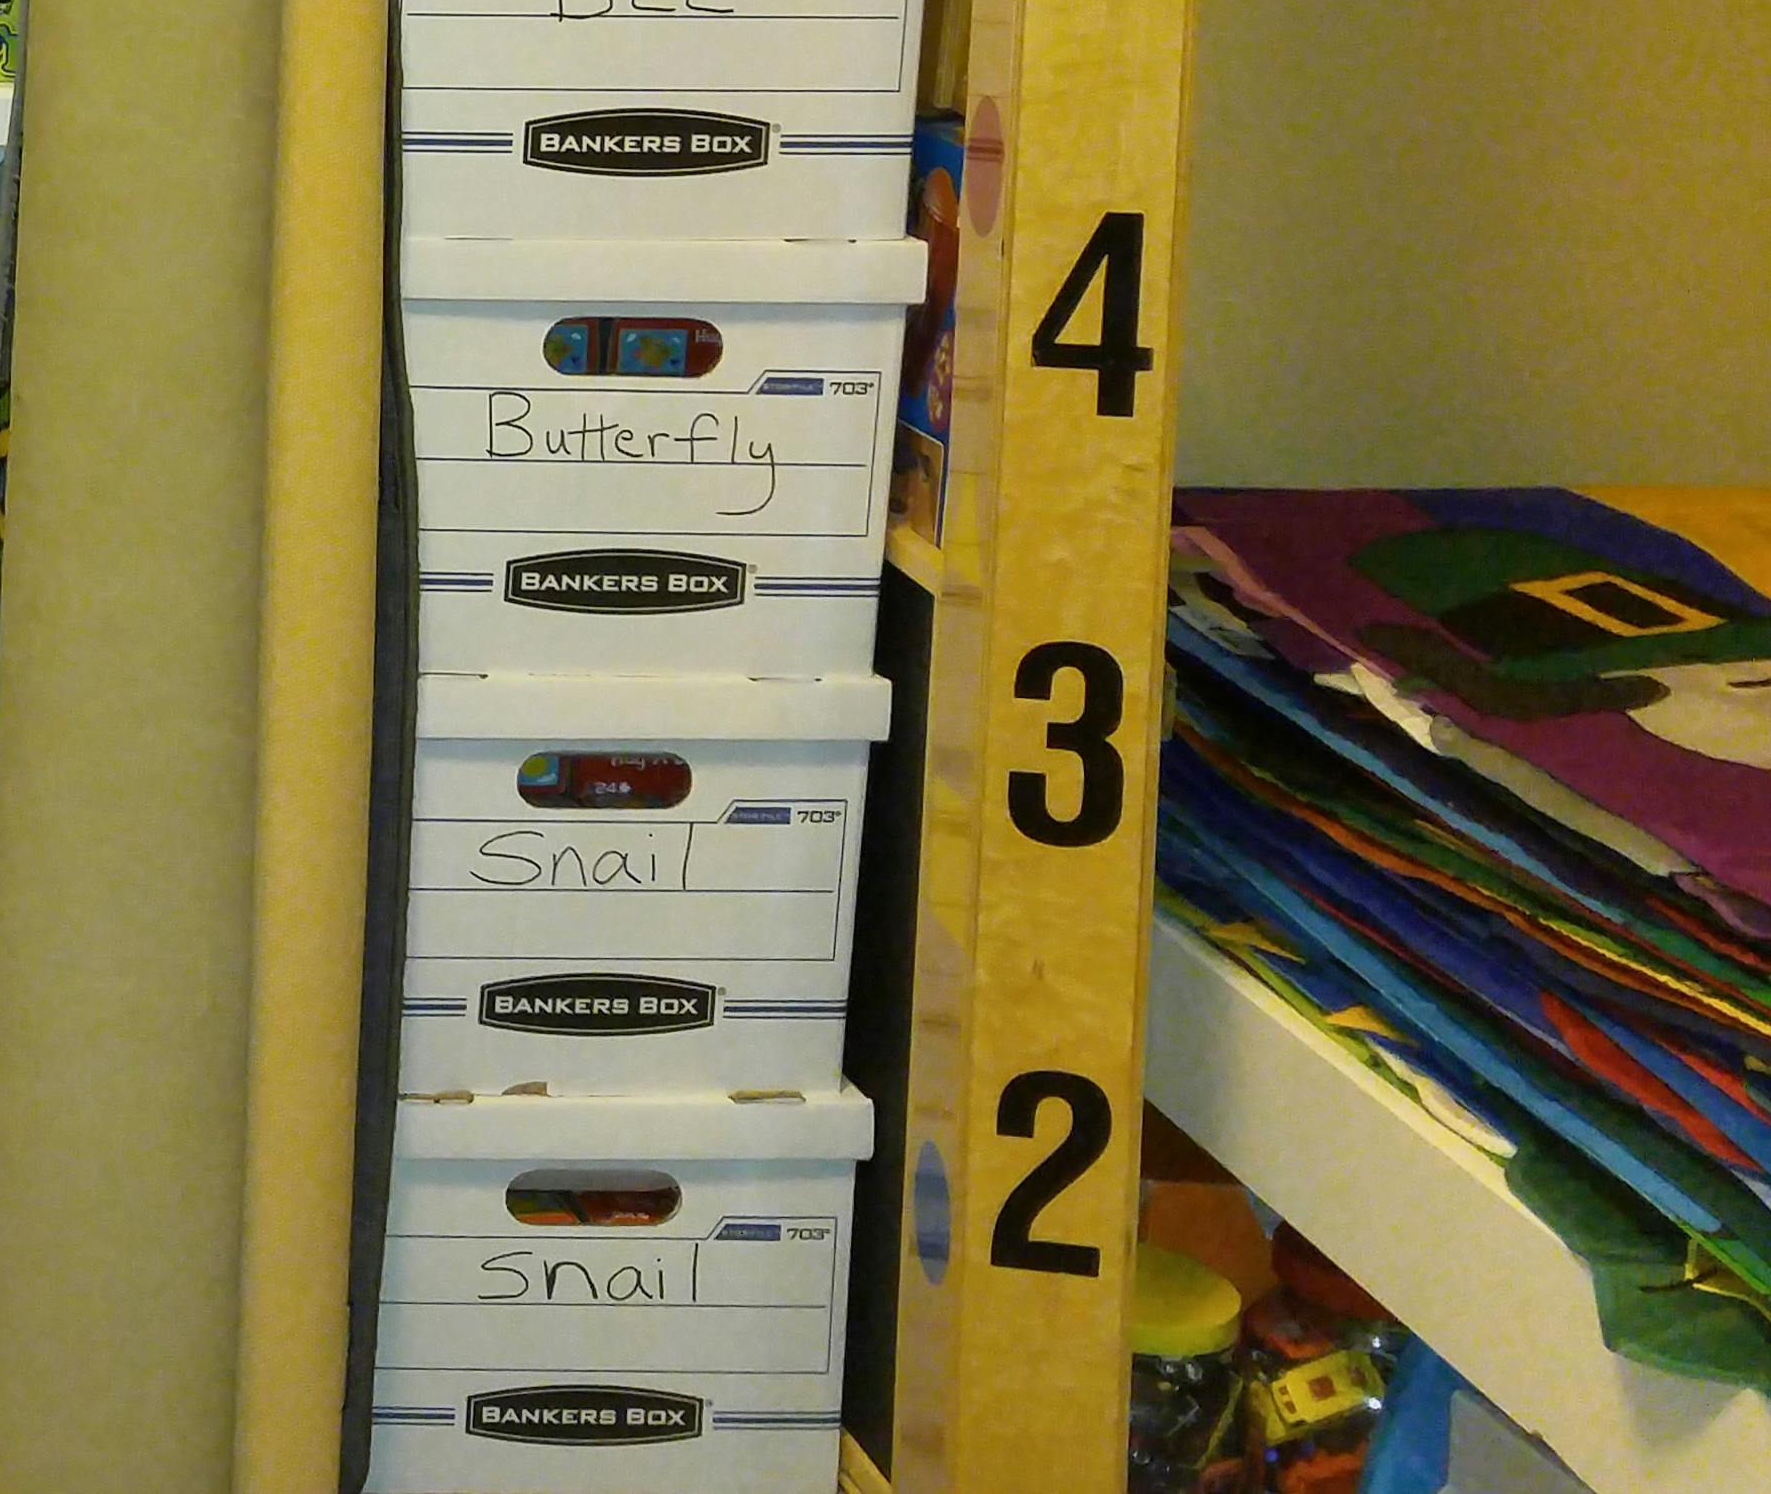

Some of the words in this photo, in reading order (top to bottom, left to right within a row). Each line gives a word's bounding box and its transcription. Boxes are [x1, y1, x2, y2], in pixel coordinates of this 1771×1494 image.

[539, 132, 681, 154] BANKERS
[691, 134, 753, 154] BOX
[1030, 212, 1154, 419] 4
[485, 392, 776, 516] Butterfly
[520, 572, 658, 592] BANKERS
[667, 573, 729, 593] BOX
[1007, 641, 1126, 849] 3
[494, 996, 629, 1014] BANKERS
[639, 997, 699, 1016] BOX
[989, 1069, 1114, 1281] 2
[482, 1407, 617, 1425] BANKERS
[626, 1407, 686, 1426] BOX
